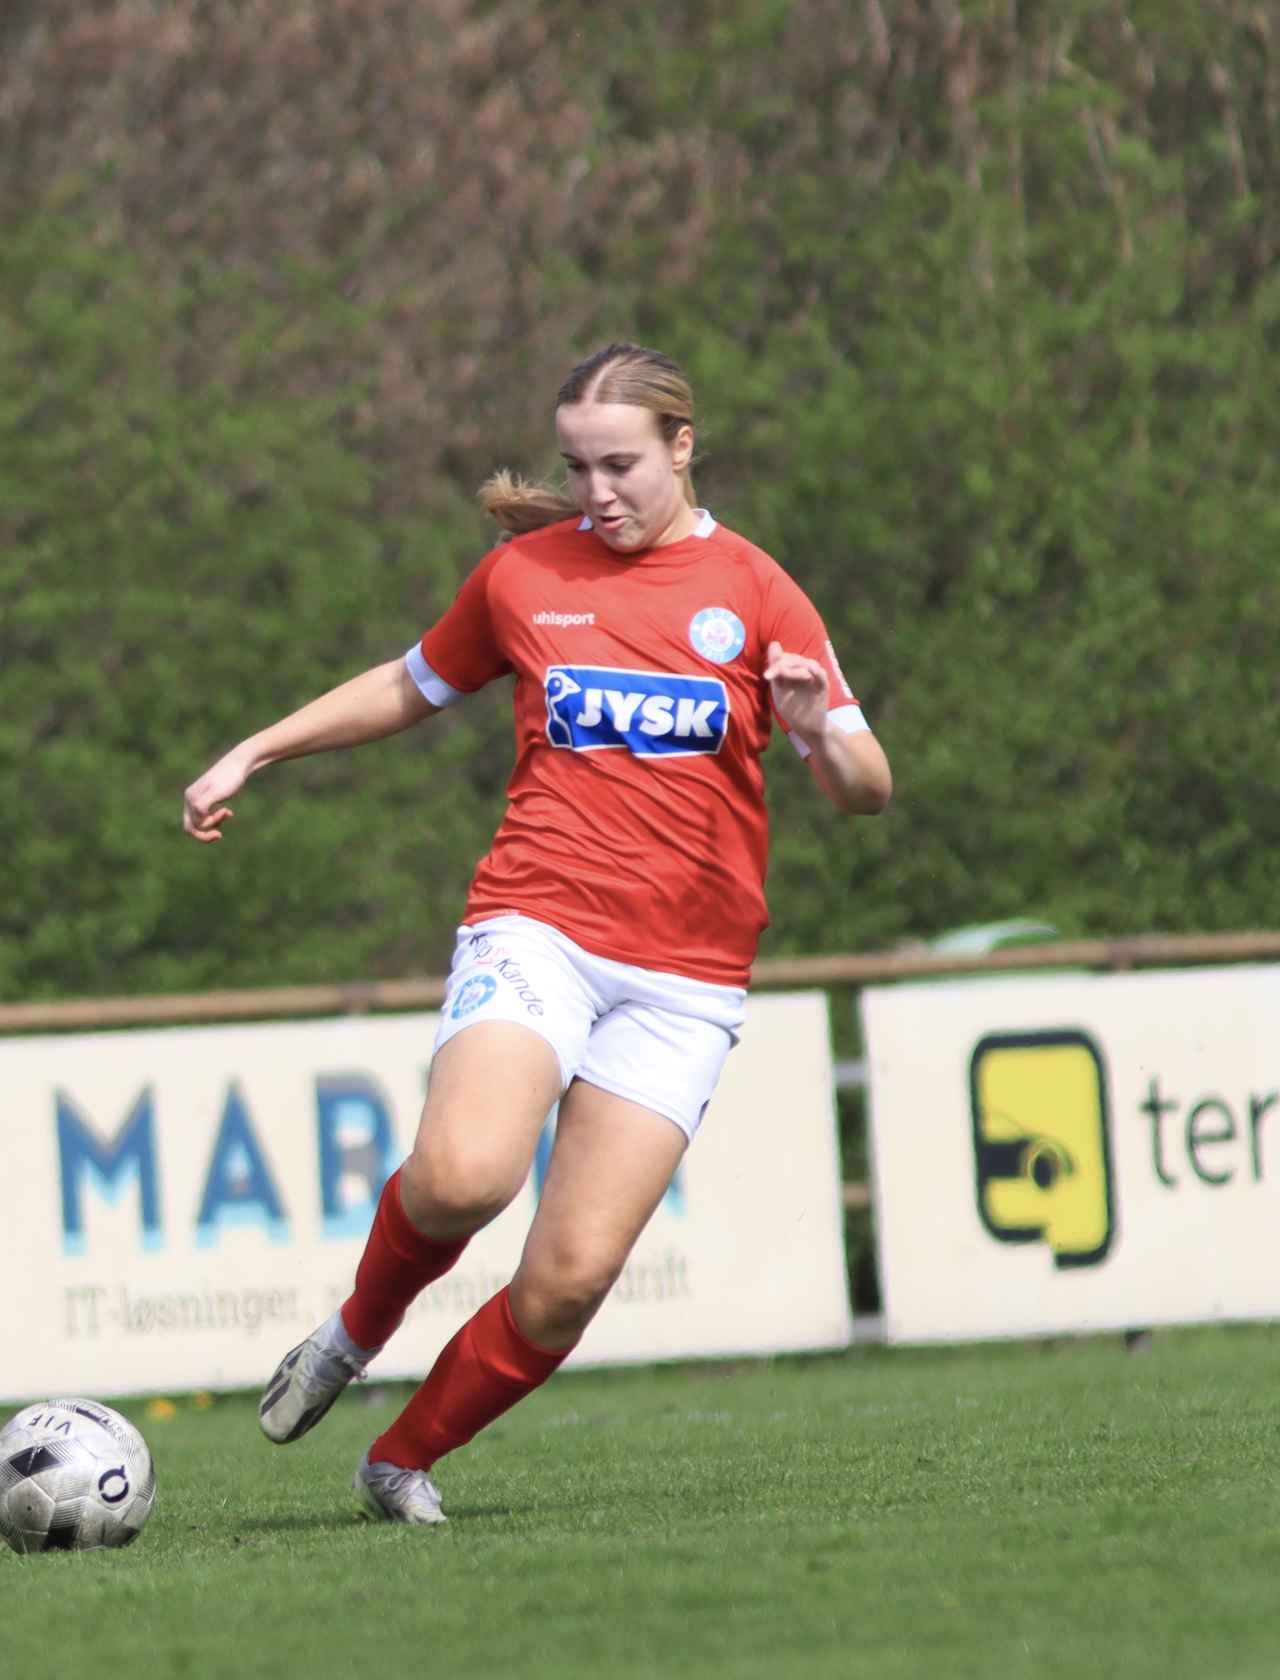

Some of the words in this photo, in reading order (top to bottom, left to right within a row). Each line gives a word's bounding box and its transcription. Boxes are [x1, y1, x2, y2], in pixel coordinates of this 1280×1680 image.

[531, 610, 596, 628] uhlsport
[576, 688, 719, 737] JYSK
[28, 1414, 72, 1436] VIF
